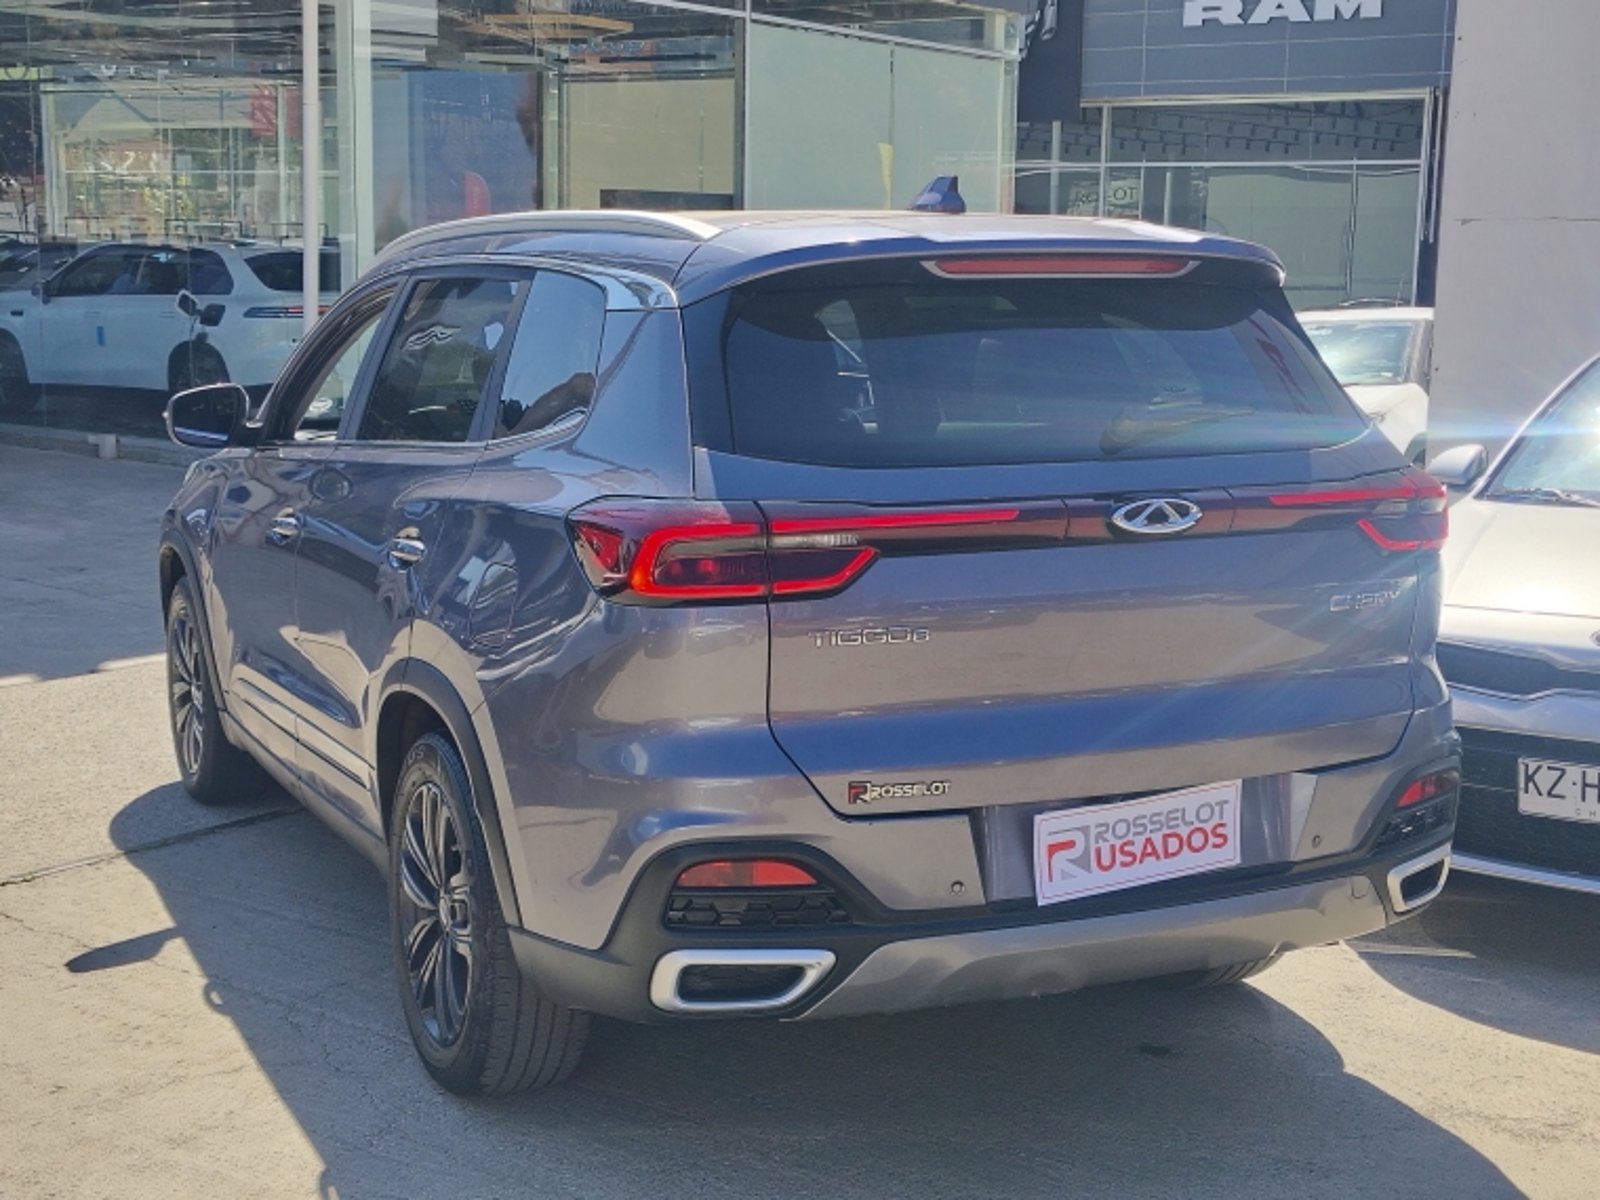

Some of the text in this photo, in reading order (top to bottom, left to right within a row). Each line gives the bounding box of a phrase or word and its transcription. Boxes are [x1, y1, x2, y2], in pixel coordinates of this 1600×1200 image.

[1182, 0, 1382, 27] RAM
[869, 782, 952, 799] ROSSELOT
[1094, 799, 1229, 845] ROSSELOT
[1095, 823, 1229, 872] USADOS
